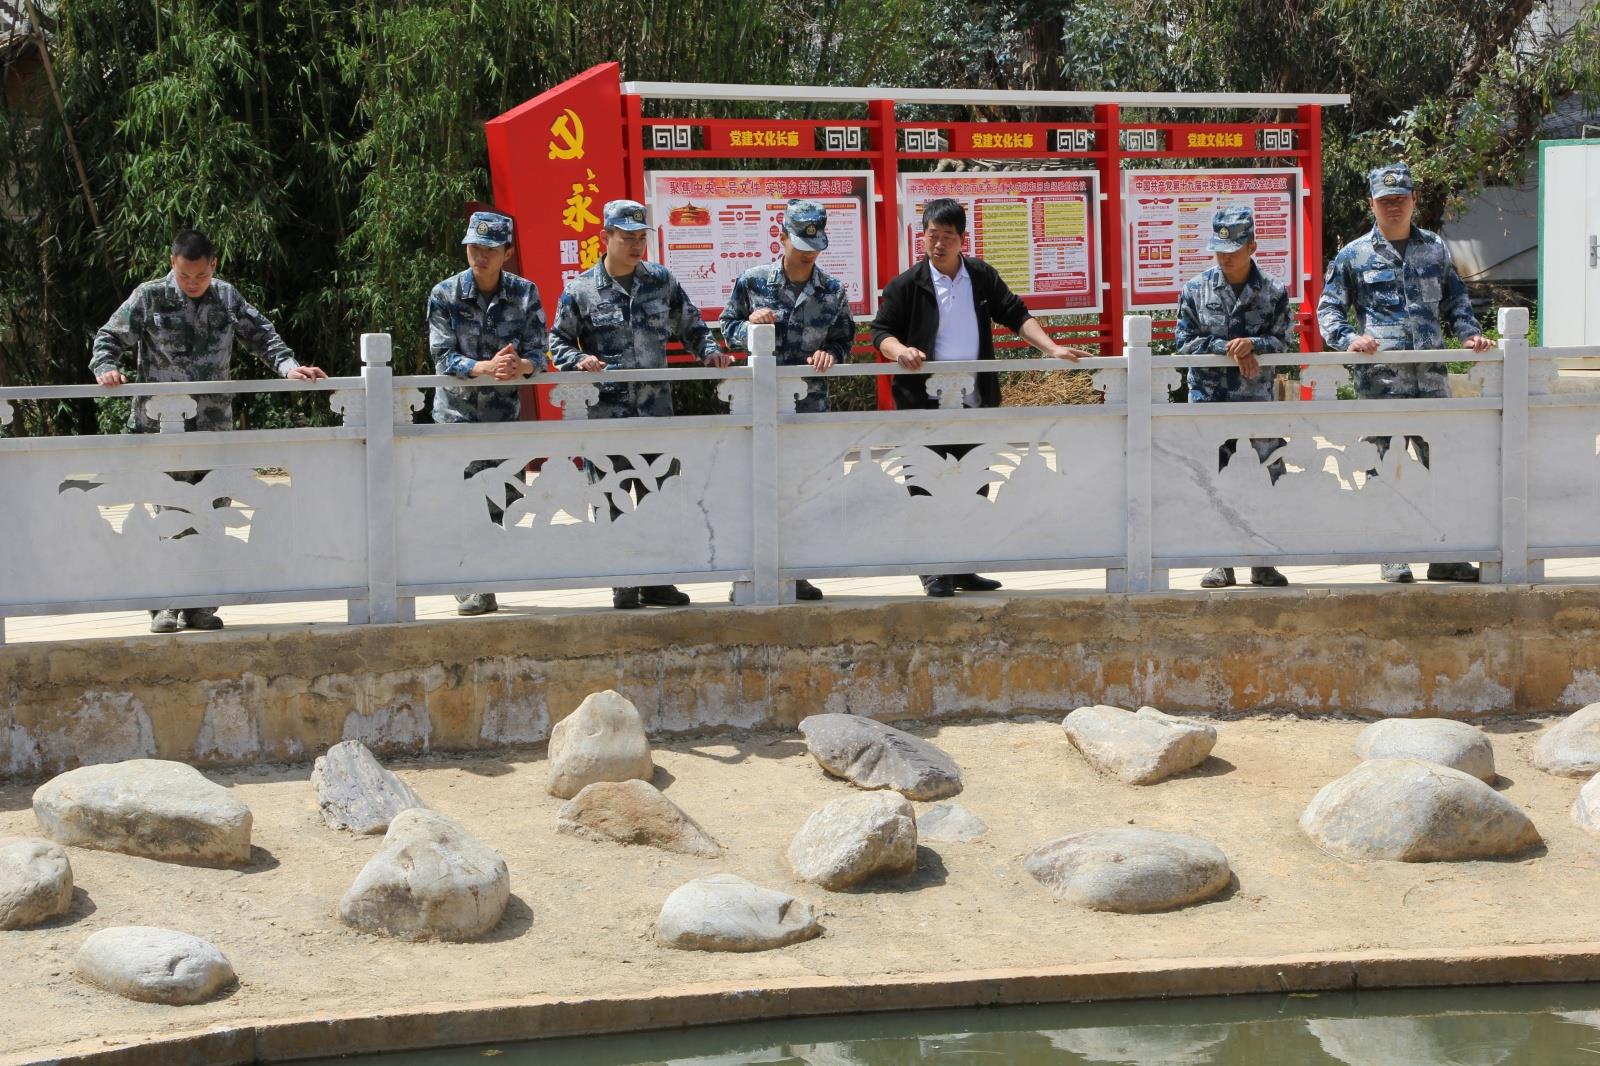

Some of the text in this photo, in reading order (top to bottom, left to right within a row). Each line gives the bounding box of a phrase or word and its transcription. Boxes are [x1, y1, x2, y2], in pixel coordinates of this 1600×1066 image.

[729, 130, 799, 147] 党建文化长廊
[972, 133, 1034, 148] 党建文化长廊
[1188, 133, 1243, 147] 党建文化长廊
[669, 180, 853, 195] 聚焦中央一号文件 实施乡村振兴战略
[1135, 178, 1288, 192] 中国共产党第十九届中央委员会第六次全体会议
